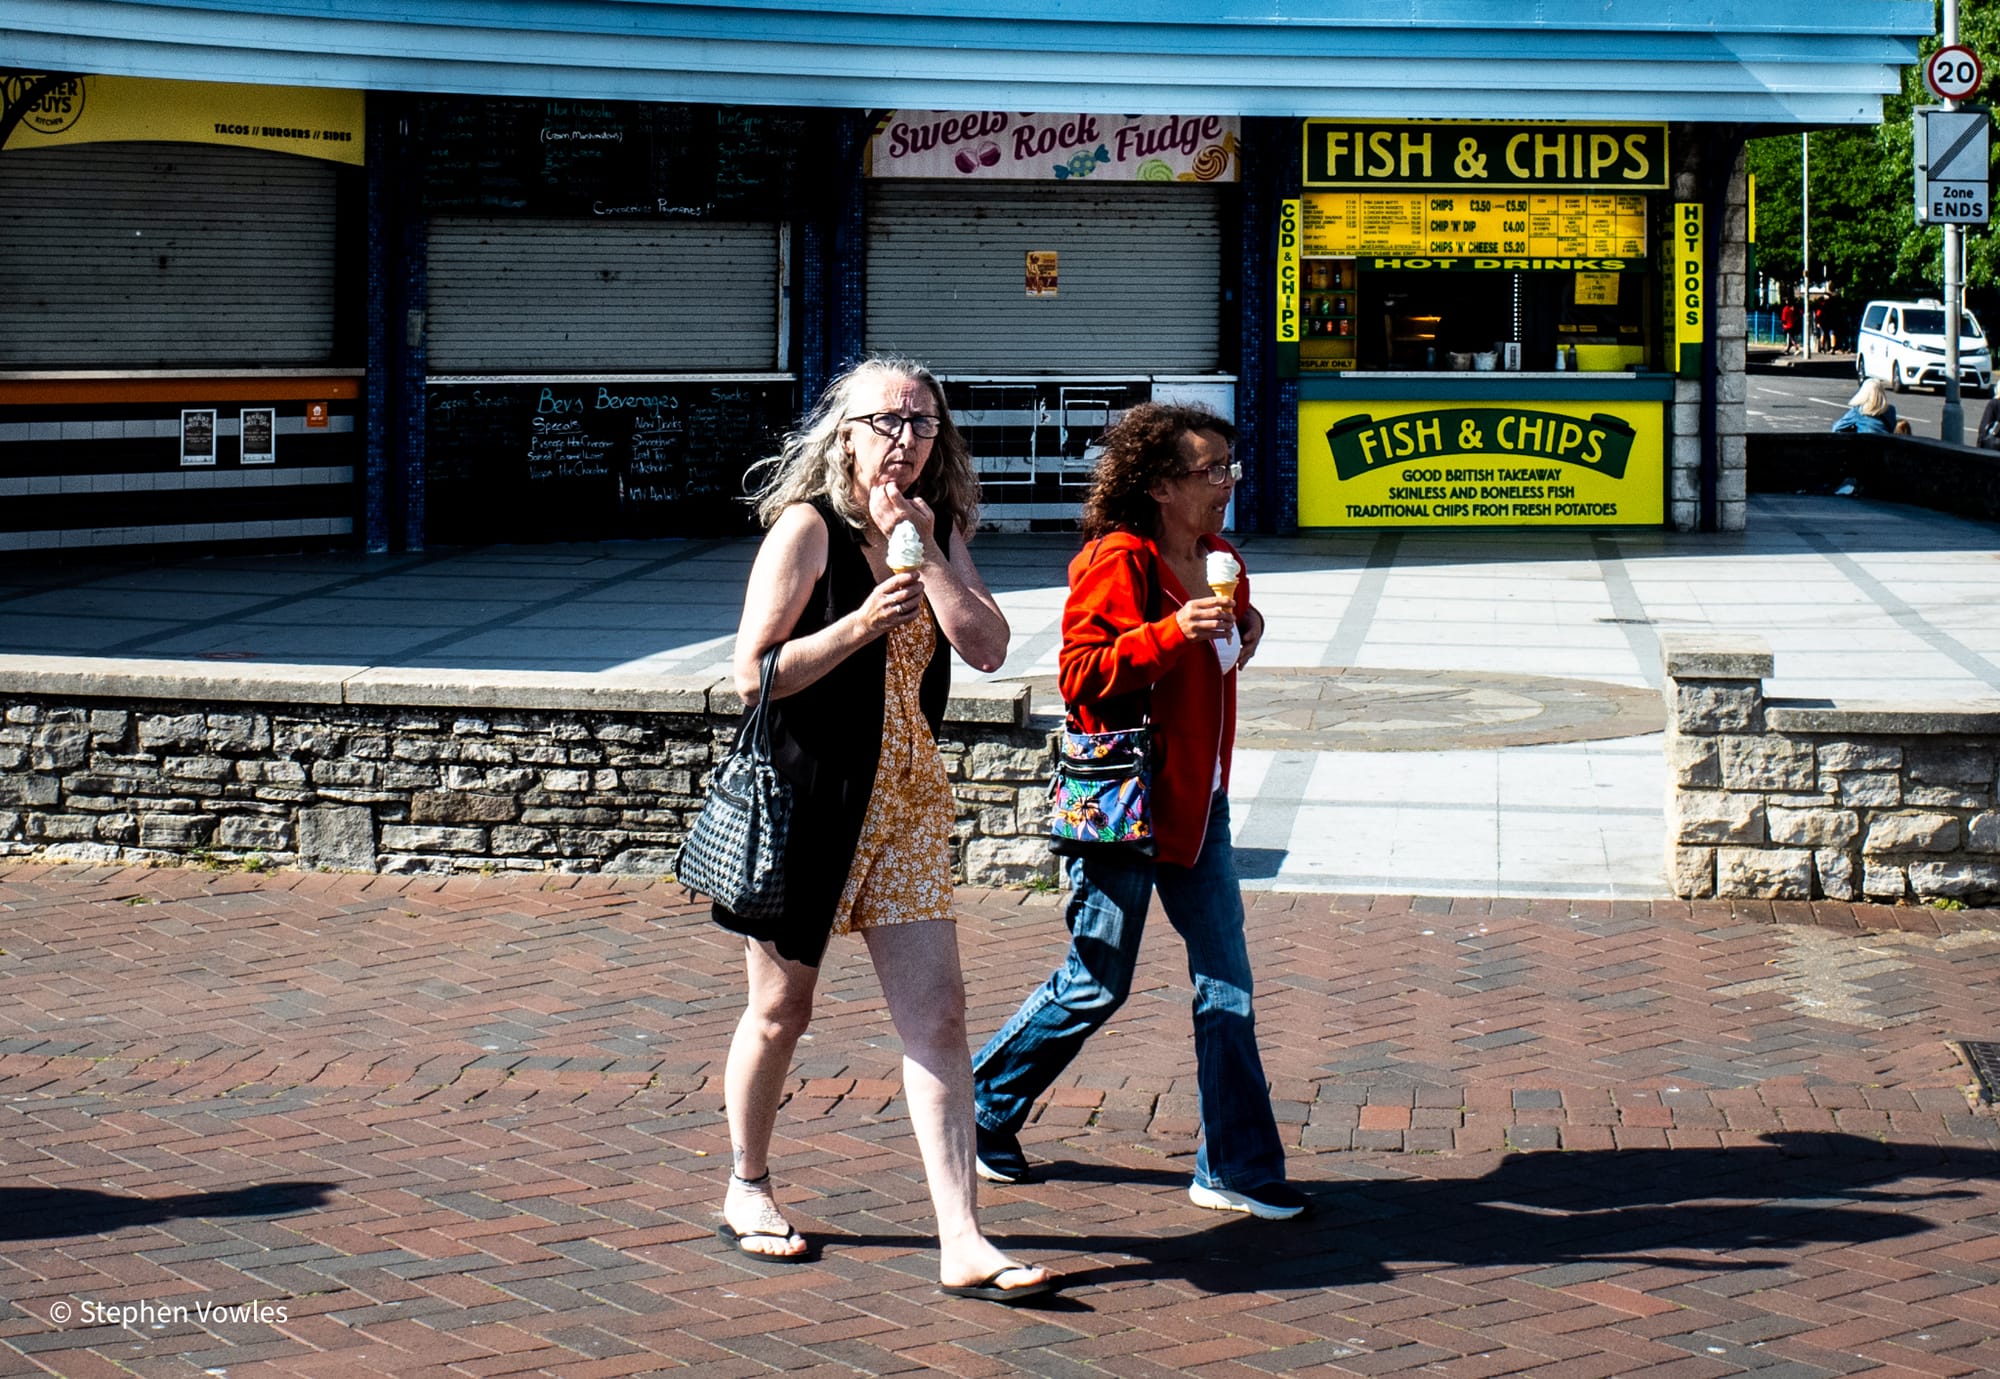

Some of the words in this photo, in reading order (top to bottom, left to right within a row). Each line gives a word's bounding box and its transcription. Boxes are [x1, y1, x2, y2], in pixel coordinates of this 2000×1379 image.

[1937, 61, 1975, 83] 20
[214, 123, 249, 135] TACOS
[262, 127, 310, 139] BURGERS
[323, 131, 352, 142] SIDES
[889, 111, 1008, 158] Sweets
[1012, 114, 1099, 161] Rock
[1115, 116, 1222, 161] Fudge
[1326, 131, 1432, 178] FISH
[1454, 137, 1488, 178] &
[1505, 133, 1650, 180] CHIPS
[1943, 186, 1974, 199] Zone
[1430, 199, 1454, 211] CHIPS
[1470, 200, 1491, 212] £3.50
[1506, 200, 1527, 212] £5.50
[1933, 202, 1983, 217] ENDS
[1281, 204, 1295, 247] COD
[1430, 220, 1449, 232] CHIP
[1463, 221, 1476, 232] DIP
[1503, 221, 1525, 233] £4.00
[1684, 206, 1699, 252] HOT
[1430, 241, 1453, 253] CHIPS
[1468, 242, 1499, 253] CHEESE
[1503, 242, 1526, 253] £5.20
[1284, 252, 1293, 262] &
[1374, 259, 1457, 269] HOT
[1474, 259, 1626, 269] DRINKS
[1684, 261, 1699, 325] DOGS
[1281, 266, 1295, 338] CHIPS
[1331, 360, 1353, 368] ONLY
[594, 386, 680, 419] Beverages
[1358, 417, 1442, 465] FISH
[1457, 419, 1484, 449] &
[1496, 416, 1607, 464] CHIPS
[1402, 469, 1442, 482] GOOD
[1445, 468, 1494, 481] BRITISH
[1497, 467, 1562, 480] TAKEAWAY
[1388, 487, 1447, 500] SKINLESS
[1450, 487, 1477, 499] AND
[1480, 487, 1544, 499] BONELESS
[1547, 486, 1574, 498] FISH
[1345, 505, 1430, 517] TRADITIONAL
[1433, 504, 1469, 517] CHIPS
[1472, 504, 1509, 516] FROM
[1512, 504, 1551, 516] FRESH
[1554, 503, 1618, 516] POTATOES
